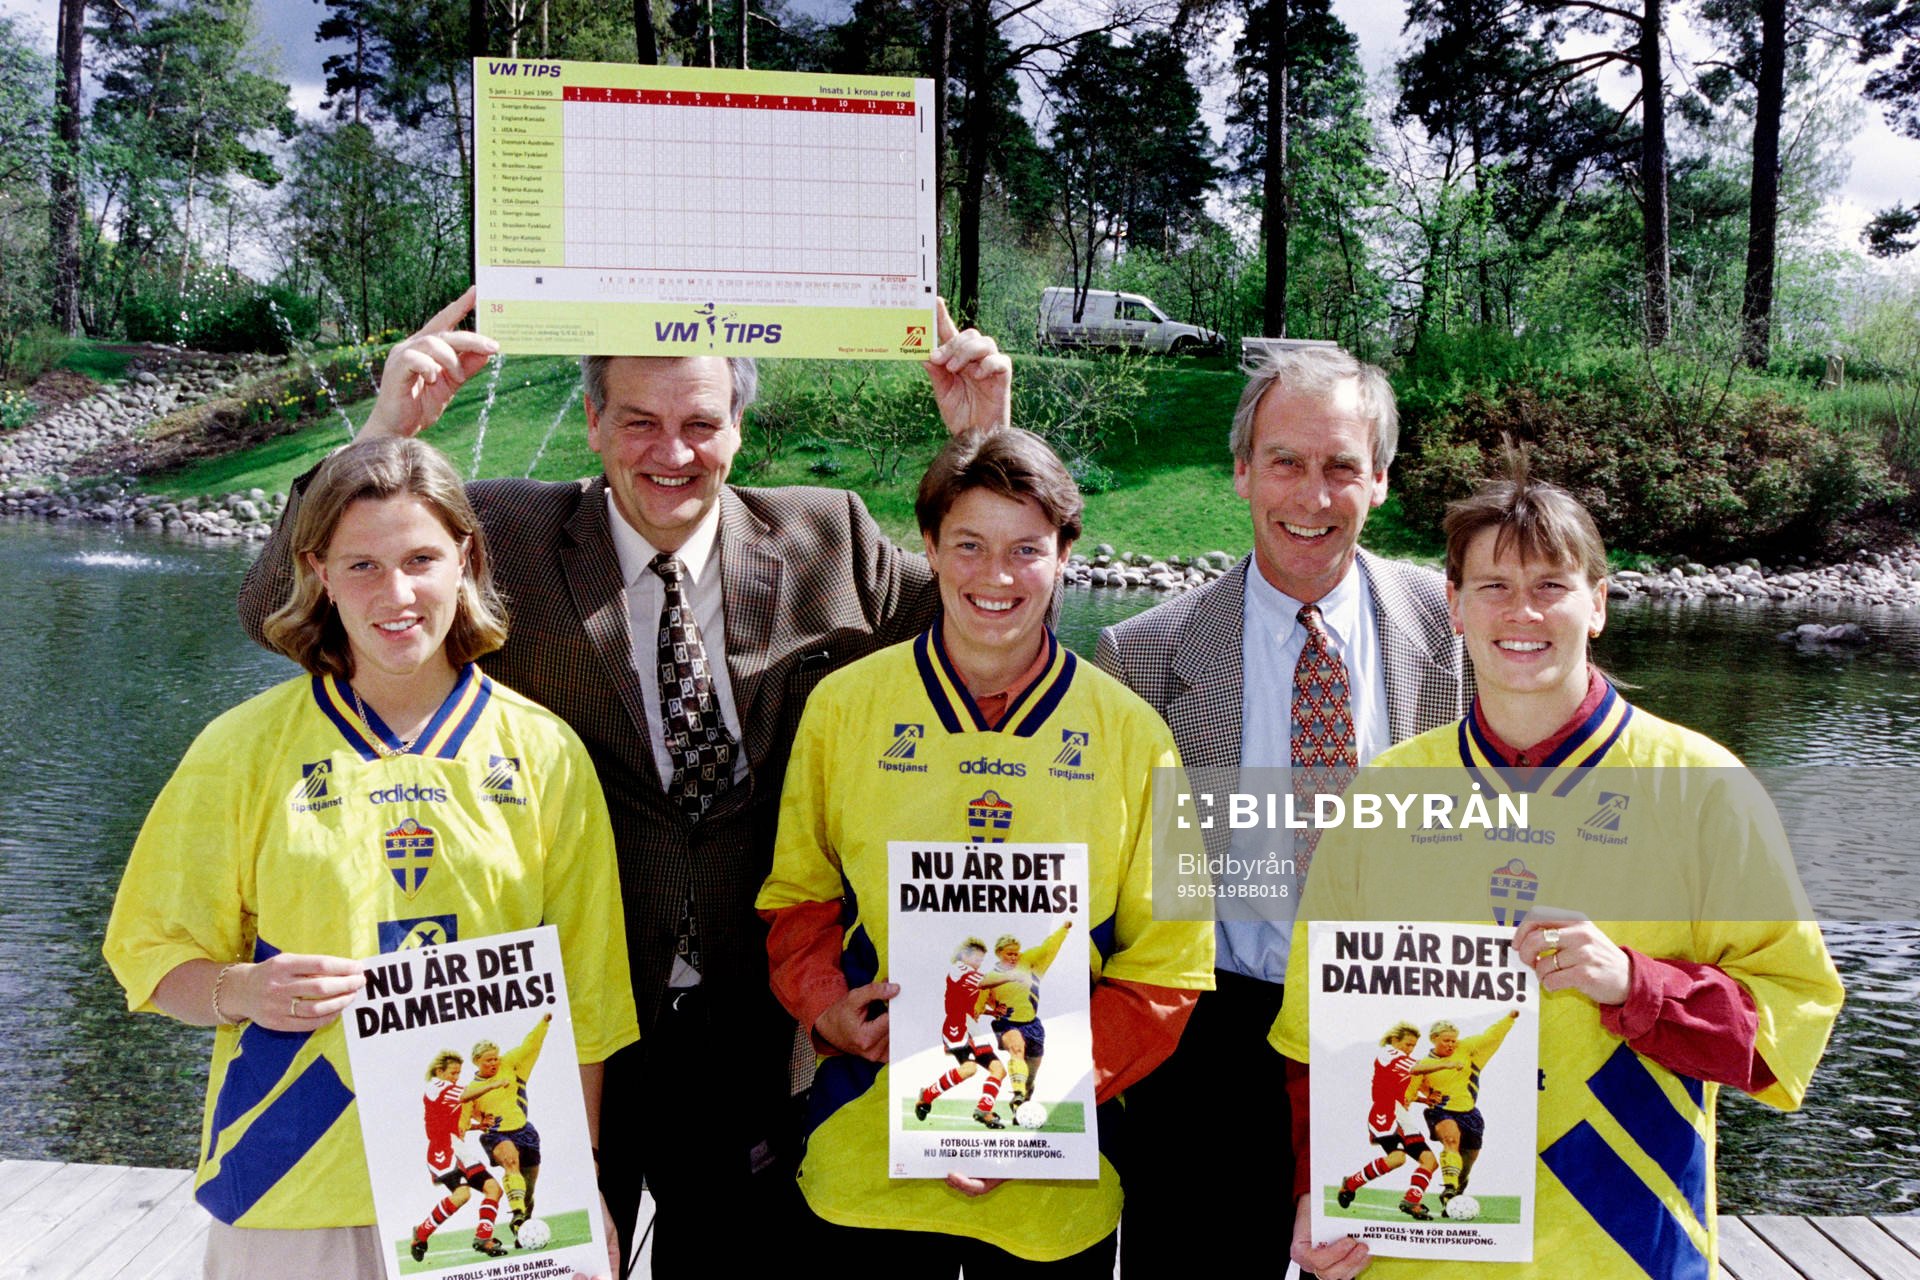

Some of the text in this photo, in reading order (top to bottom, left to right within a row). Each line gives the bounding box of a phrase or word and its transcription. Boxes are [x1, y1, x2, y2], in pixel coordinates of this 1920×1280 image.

[489, 63, 561, 78] VM TIPS
[495, 88, 507, 97] juni
[523, 90, 535, 98] juni
[575, 88, 581, 96] 1
[606, 89, 612, 97] 2
[695, 93, 701, 101] 5
[725, 94, 731, 102] 6
[811, 98, 817, 106] 9
[839, 100, 848, 108] 10
[867, 101, 877, 109] 11
[896, 102, 906, 110] 12
[819, 85, 911, 99] Insats 1 krona per rad
[490, 303, 504, 313] 38
[655, 321, 782, 344] VM TIPS
[878, 760, 928, 774] Tipstjänst
[959, 757, 1027, 777] adidas
[1048, 768, 1095, 781] Tipstjänst
[370, 784, 447, 804] adidas
[1410, 833, 1463, 845] Tipstjänst
[1484, 824, 1556, 845] adidas
[1576, 828, 1628, 845] Tipstjänst
[912, 846, 1065, 881] NU ÄR DET
[901, 883, 1078, 913] DAMERNAS!
[1336, 925, 1513, 968] NU ÄR DET
[364, 940, 535, 1000] NU ÄR DET
[1322, 963, 1526, 1003] DAMERNAS!
[355, 972, 557, 1039] DAMERNAS!
[941, 1138, 1051, 1148] FOTBOLLS-VM FÖR DAMER.
[924, 1149, 1066, 1159] NU MED EGEN STRYKTIPSKUPONG.
[1364, 1226, 1481, 1237] FOTBOLLS-VM FÖR DAMER.
[1385, 1234, 1407, 1242] EGEN
[1409, 1235, 1497, 1246] STRYKTIPSKUPONG.
[504, 1265, 520, 1275] FÖR
[523, 1258, 558, 1271] DAMER.
